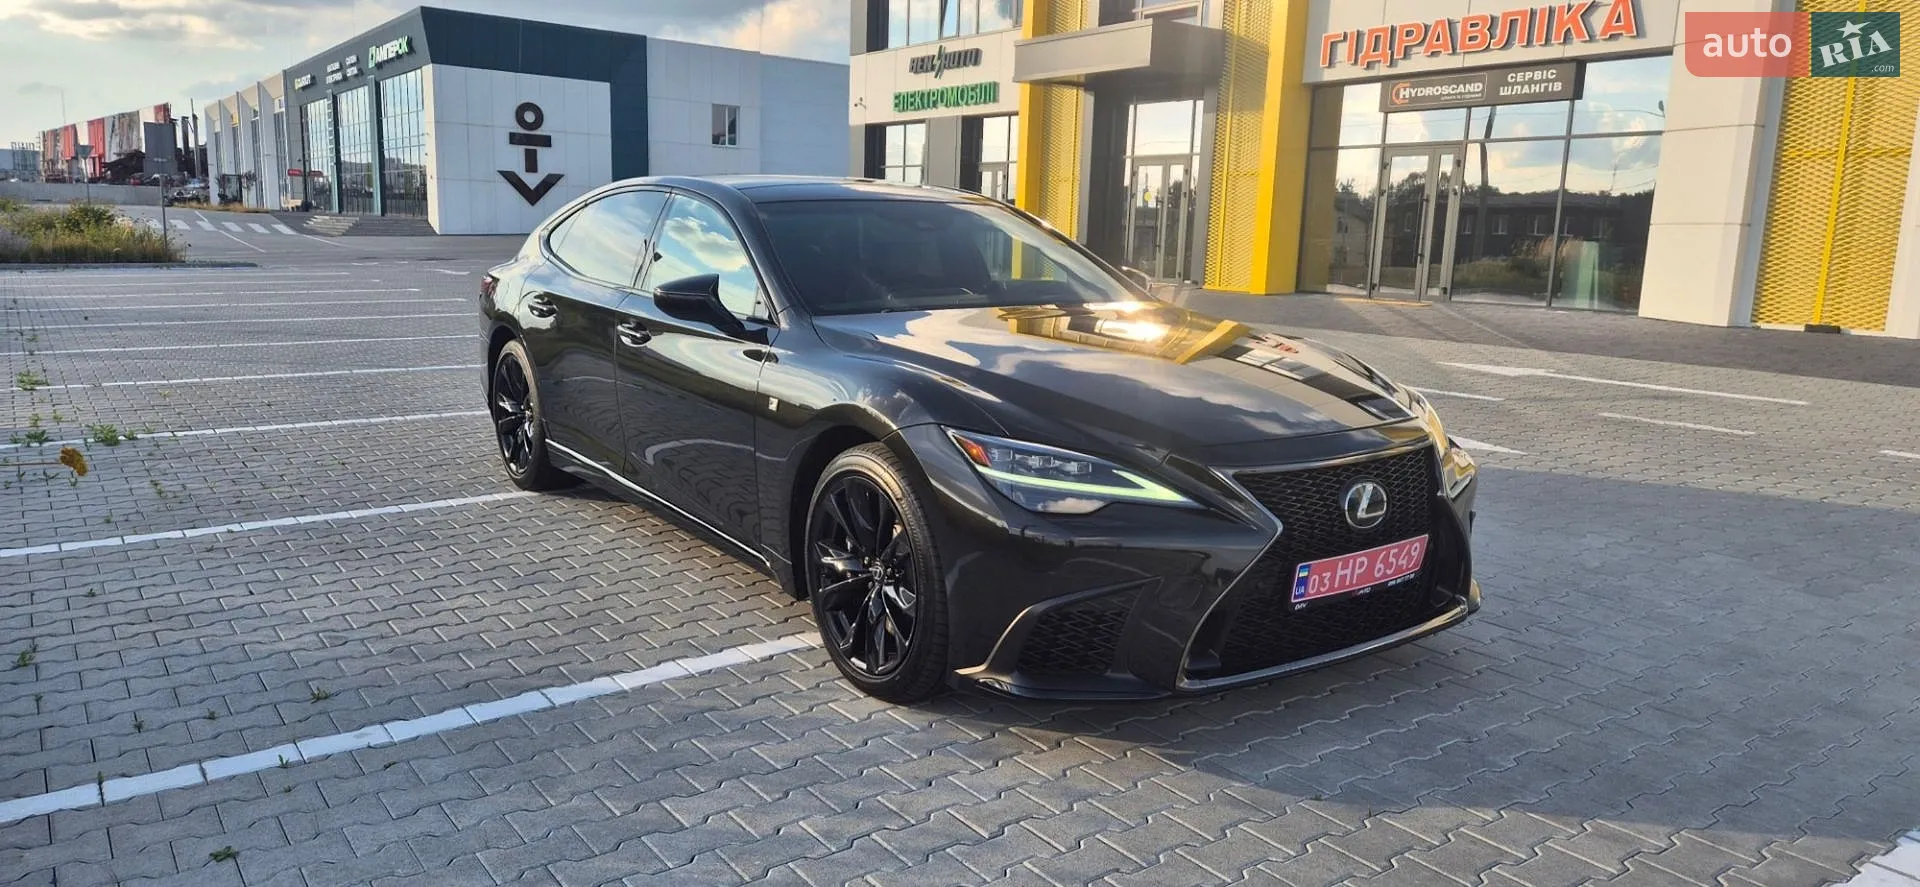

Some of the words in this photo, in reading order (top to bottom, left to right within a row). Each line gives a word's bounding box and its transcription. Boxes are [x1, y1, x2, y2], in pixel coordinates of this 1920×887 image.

[1319, 0, 1637, 68] ГІДРАВЛІКА
[1507, 69, 1558, 83] СЕРВІС
[893, 81, 999, 112] ЕЛЕКТРОМОБІЛІ
[1399, 82, 1483, 99] HYDROSCAND
[1499, 81, 1562, 96] ШЛАНГІВ
[1308, 571, 1332, 594] 03
[1334, 556, 1368, 588] HP
[1373, 541, 1421, 578] 6549
